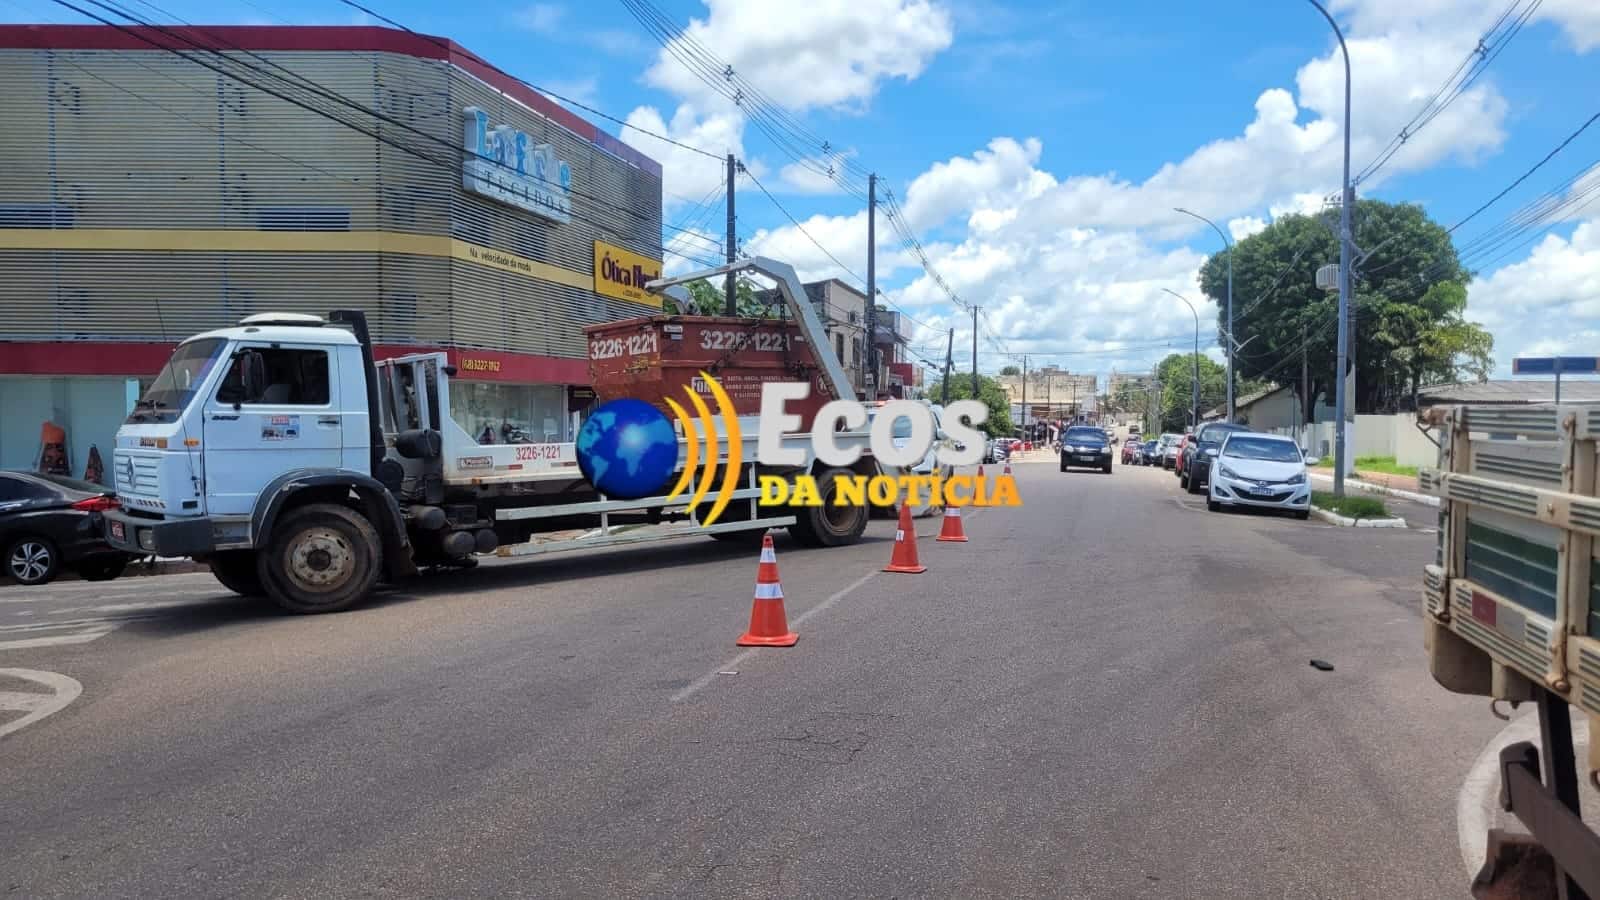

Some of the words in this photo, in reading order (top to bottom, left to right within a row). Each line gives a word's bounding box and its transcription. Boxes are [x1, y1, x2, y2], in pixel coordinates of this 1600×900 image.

[485, 170, 567, 213] TECIDOS
[469, 247, 478, 258] Na
[481, 251, 509, 266] velocidade
[518, 262, 532, 272] moda
[601, 251, 631, 286] Ótica
[516, 446, 561, 460] 3226-1221
